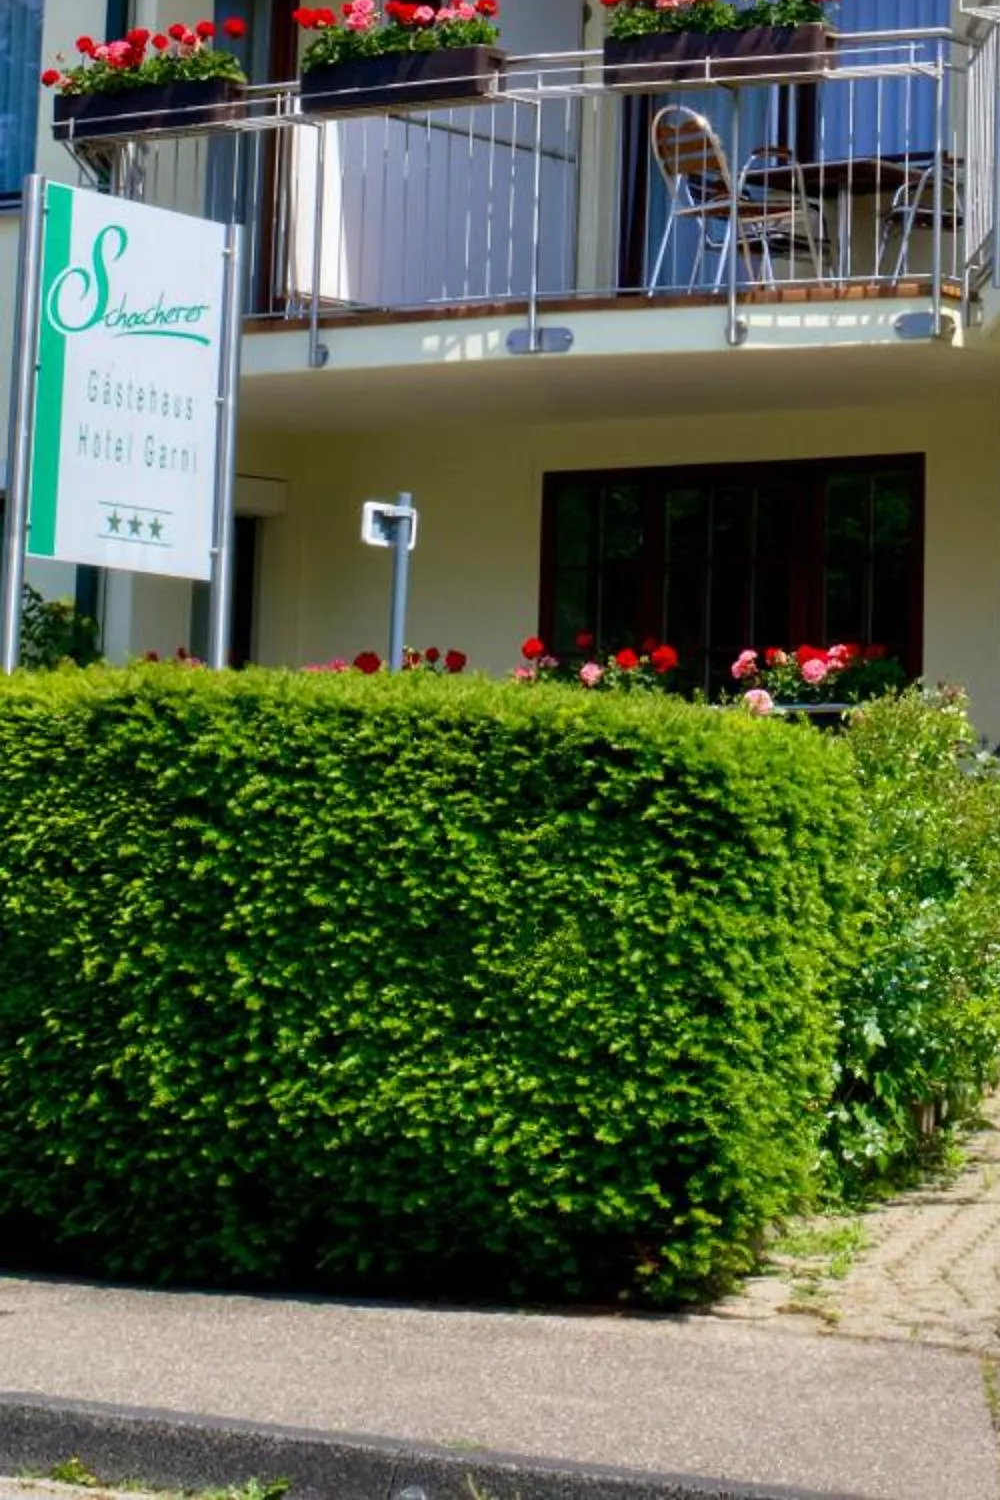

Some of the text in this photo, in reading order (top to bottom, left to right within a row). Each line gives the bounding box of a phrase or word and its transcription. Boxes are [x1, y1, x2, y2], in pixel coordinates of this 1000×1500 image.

[49, 225, 210, 332] Schacherer
[87, 369, 194, 421] Gästehaus
[78, 423, 198, 474] Hotel Garni
